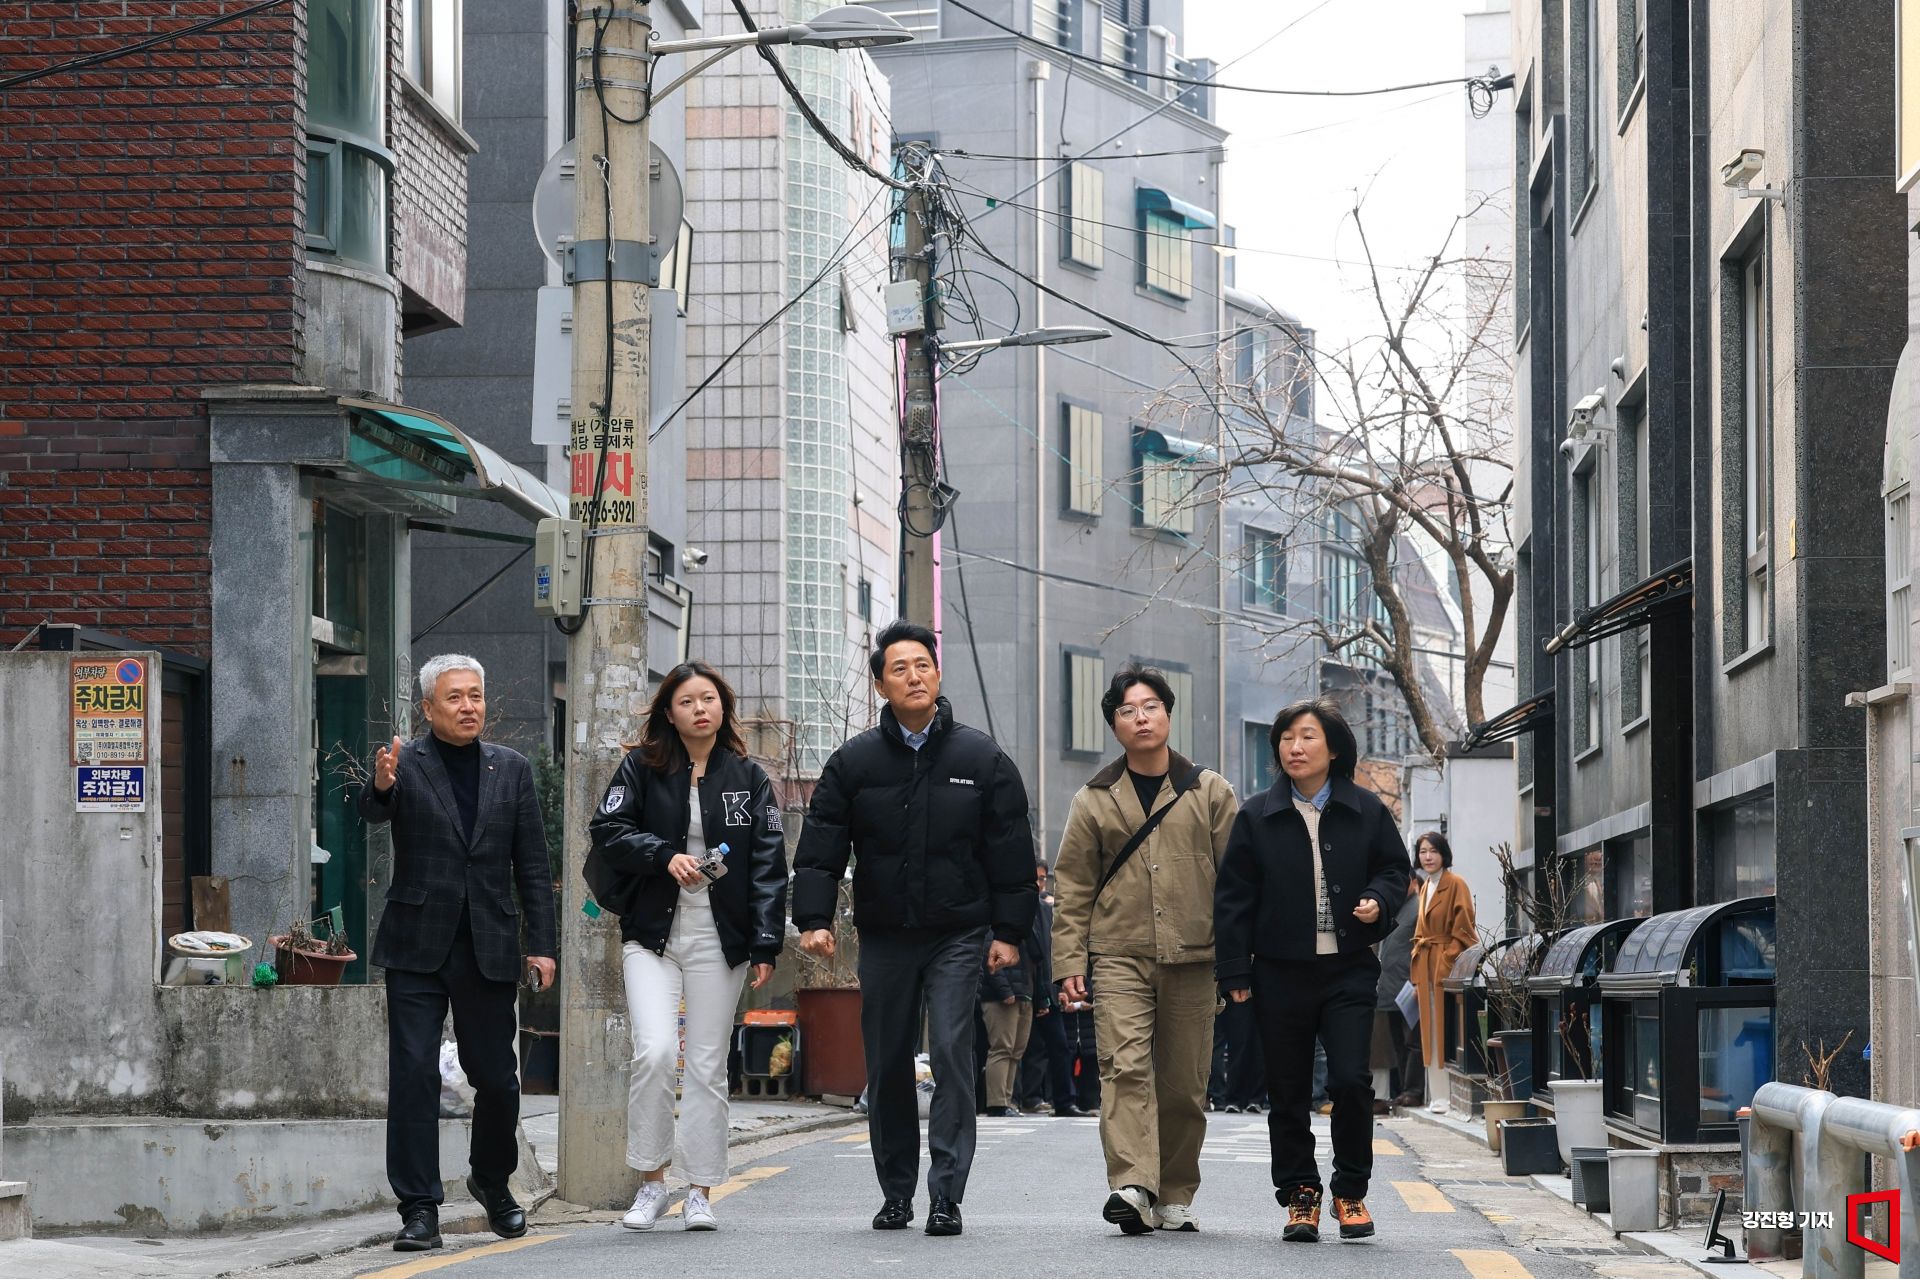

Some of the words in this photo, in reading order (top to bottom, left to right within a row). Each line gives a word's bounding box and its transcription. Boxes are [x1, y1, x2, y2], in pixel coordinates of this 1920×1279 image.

[593, 434, 634, 449] 문제차
[571, 451, 634, 497] 폐차
[75, 666, 107, 679] 외부차량
[75, 684, 143, 711] 주차금지
[91, 769, 131, 781] 외부차량
[82, 781, 140, 796] 주차금지
[722, 790, 752, 826] K
